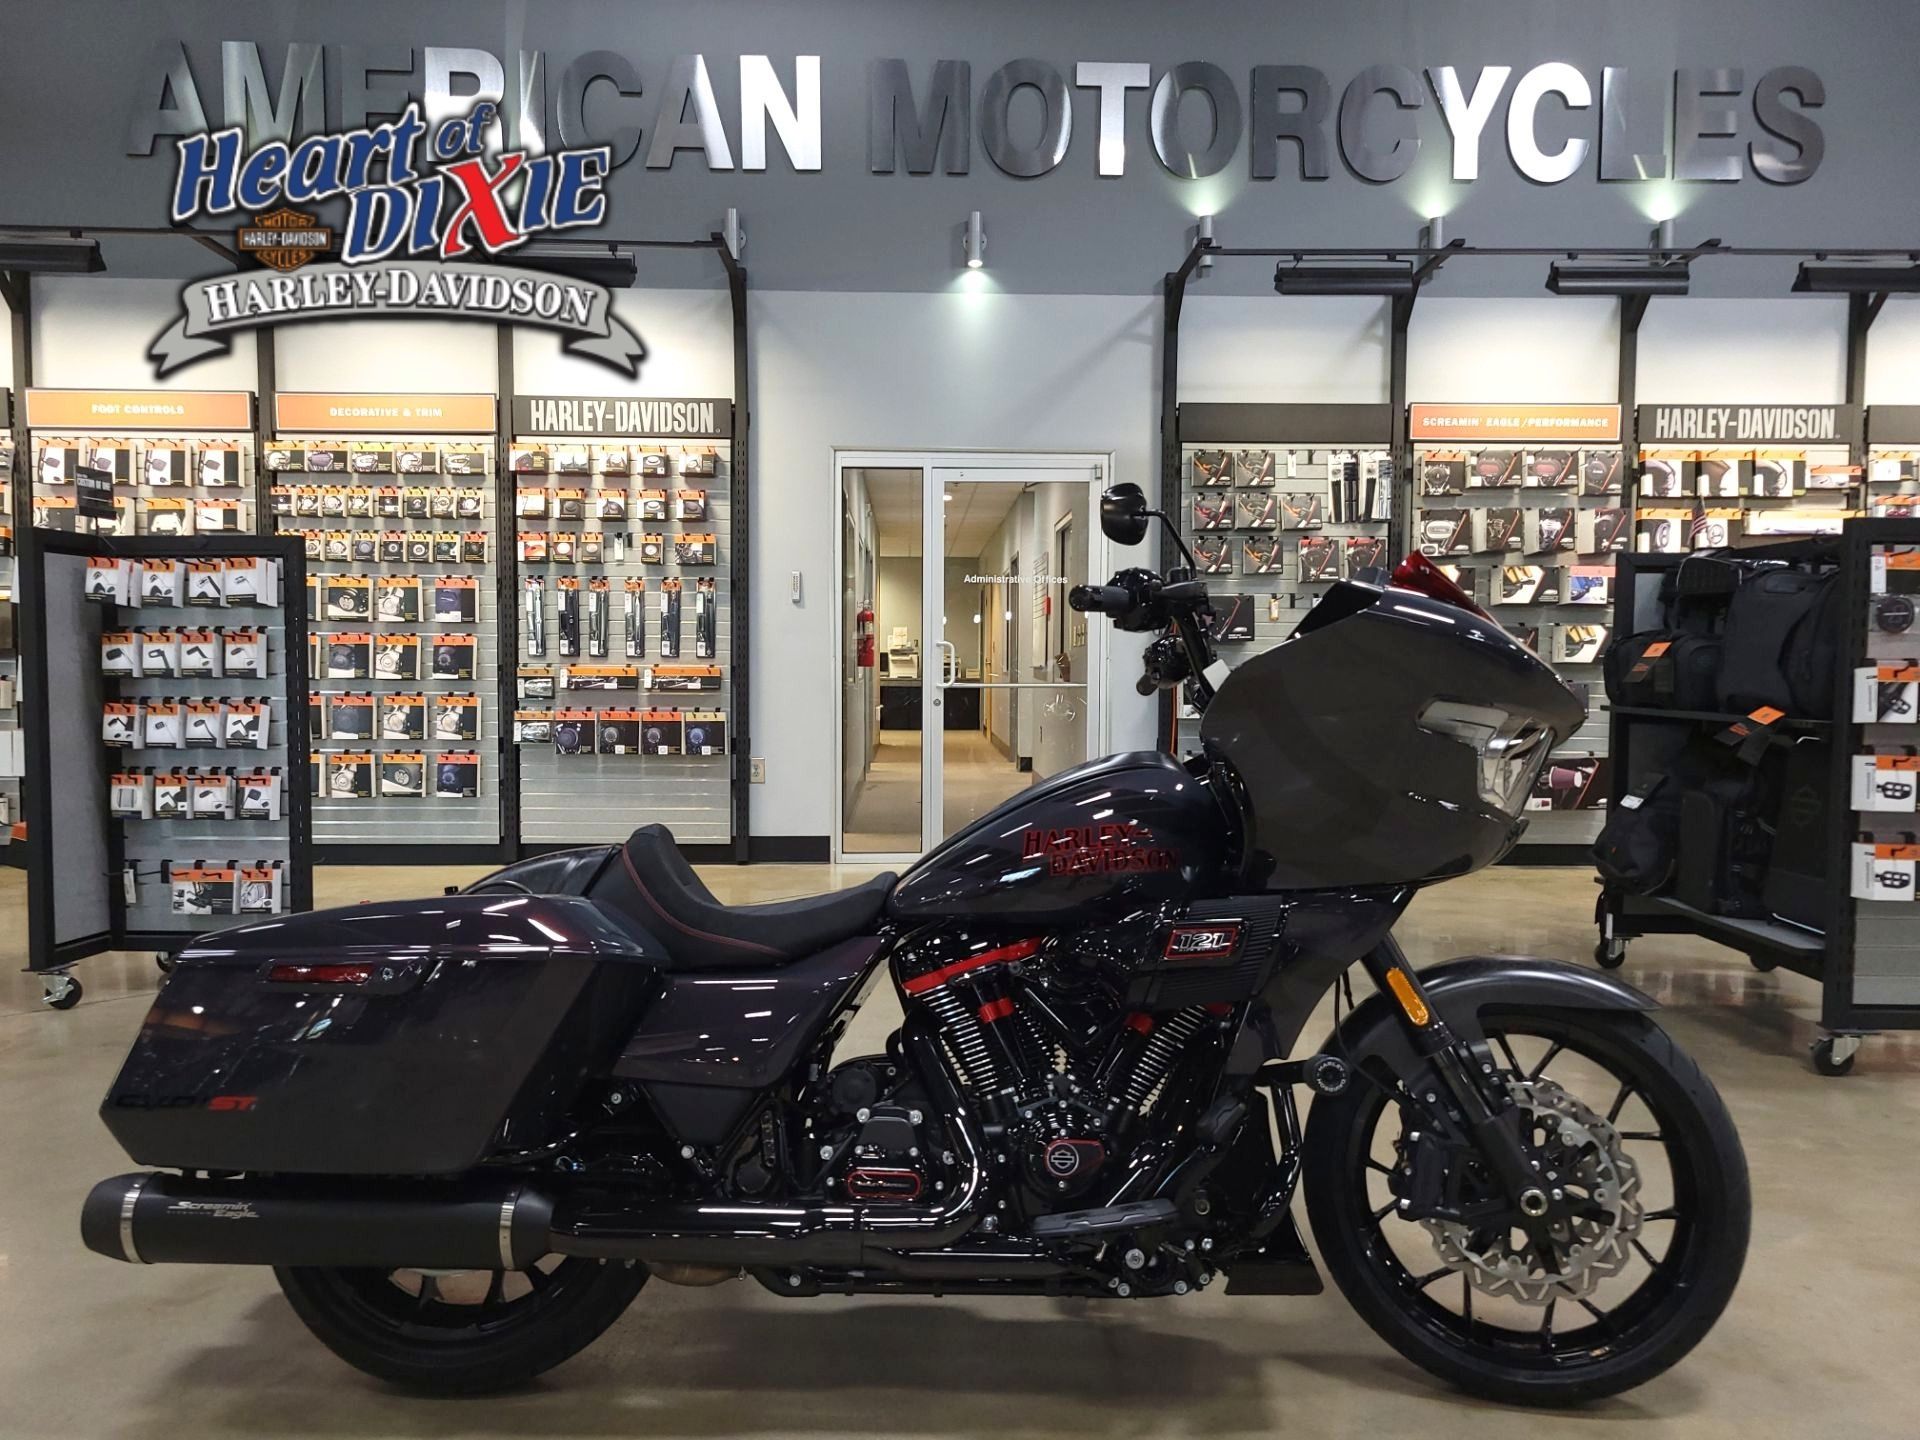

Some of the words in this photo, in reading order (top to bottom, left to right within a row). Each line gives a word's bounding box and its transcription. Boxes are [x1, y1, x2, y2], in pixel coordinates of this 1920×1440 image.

[127, 39, 822, 171] AMERICAN
[870, 59, 1826, 185] MOTORCYCLES
[91, 404, 121, 414] FOOT
[123, 404, 184, 415] CONTROLS
[329, 407, 399, 417] DECORATIVE
[415, 407, 443, 417] TRIM
[530, 399, 714, 433] HARLEY-DAVIDSON
[1655, 407, 1836, 439] HARLEY-DAVIDSON
[963, 574, 1031, 584] Administrative
[1033, 574, 1069, 584] Offices
[1050, 846, 1179, 877] DAVIDSON
[1179, 932, 1225, 949] 121
